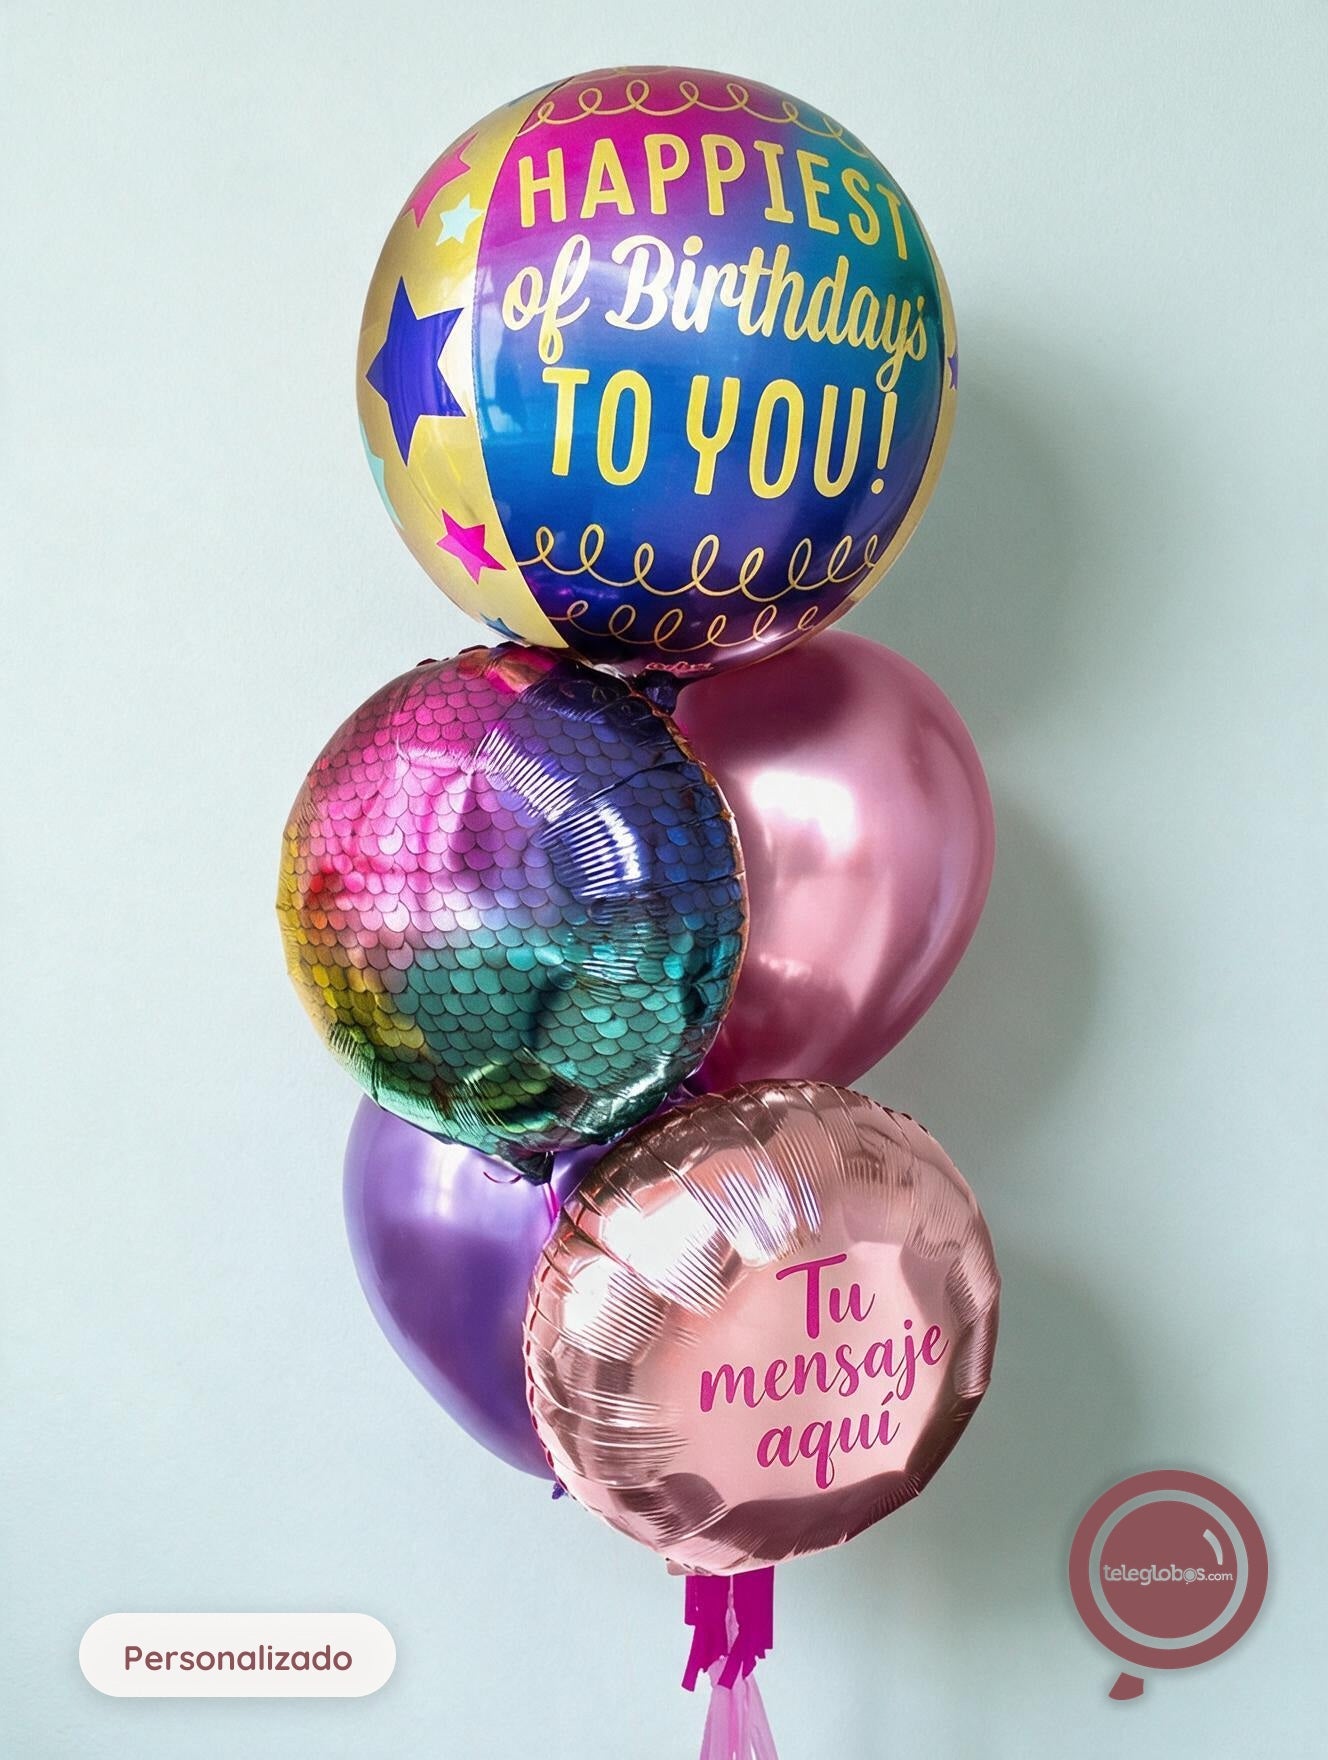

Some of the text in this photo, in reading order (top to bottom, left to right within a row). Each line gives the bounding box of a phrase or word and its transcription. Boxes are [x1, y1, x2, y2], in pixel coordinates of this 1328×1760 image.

[518, 133, 908, 260] HAPPIEST
[501, 234, 928, 392] of Birthdays
[541, 367, 898, 500] TO YOU!
[775, 1253, 876, 1339] Tu
[700, 1319, 950, 1413] mensaje
[756, 1391, 901, 1490] aquí
